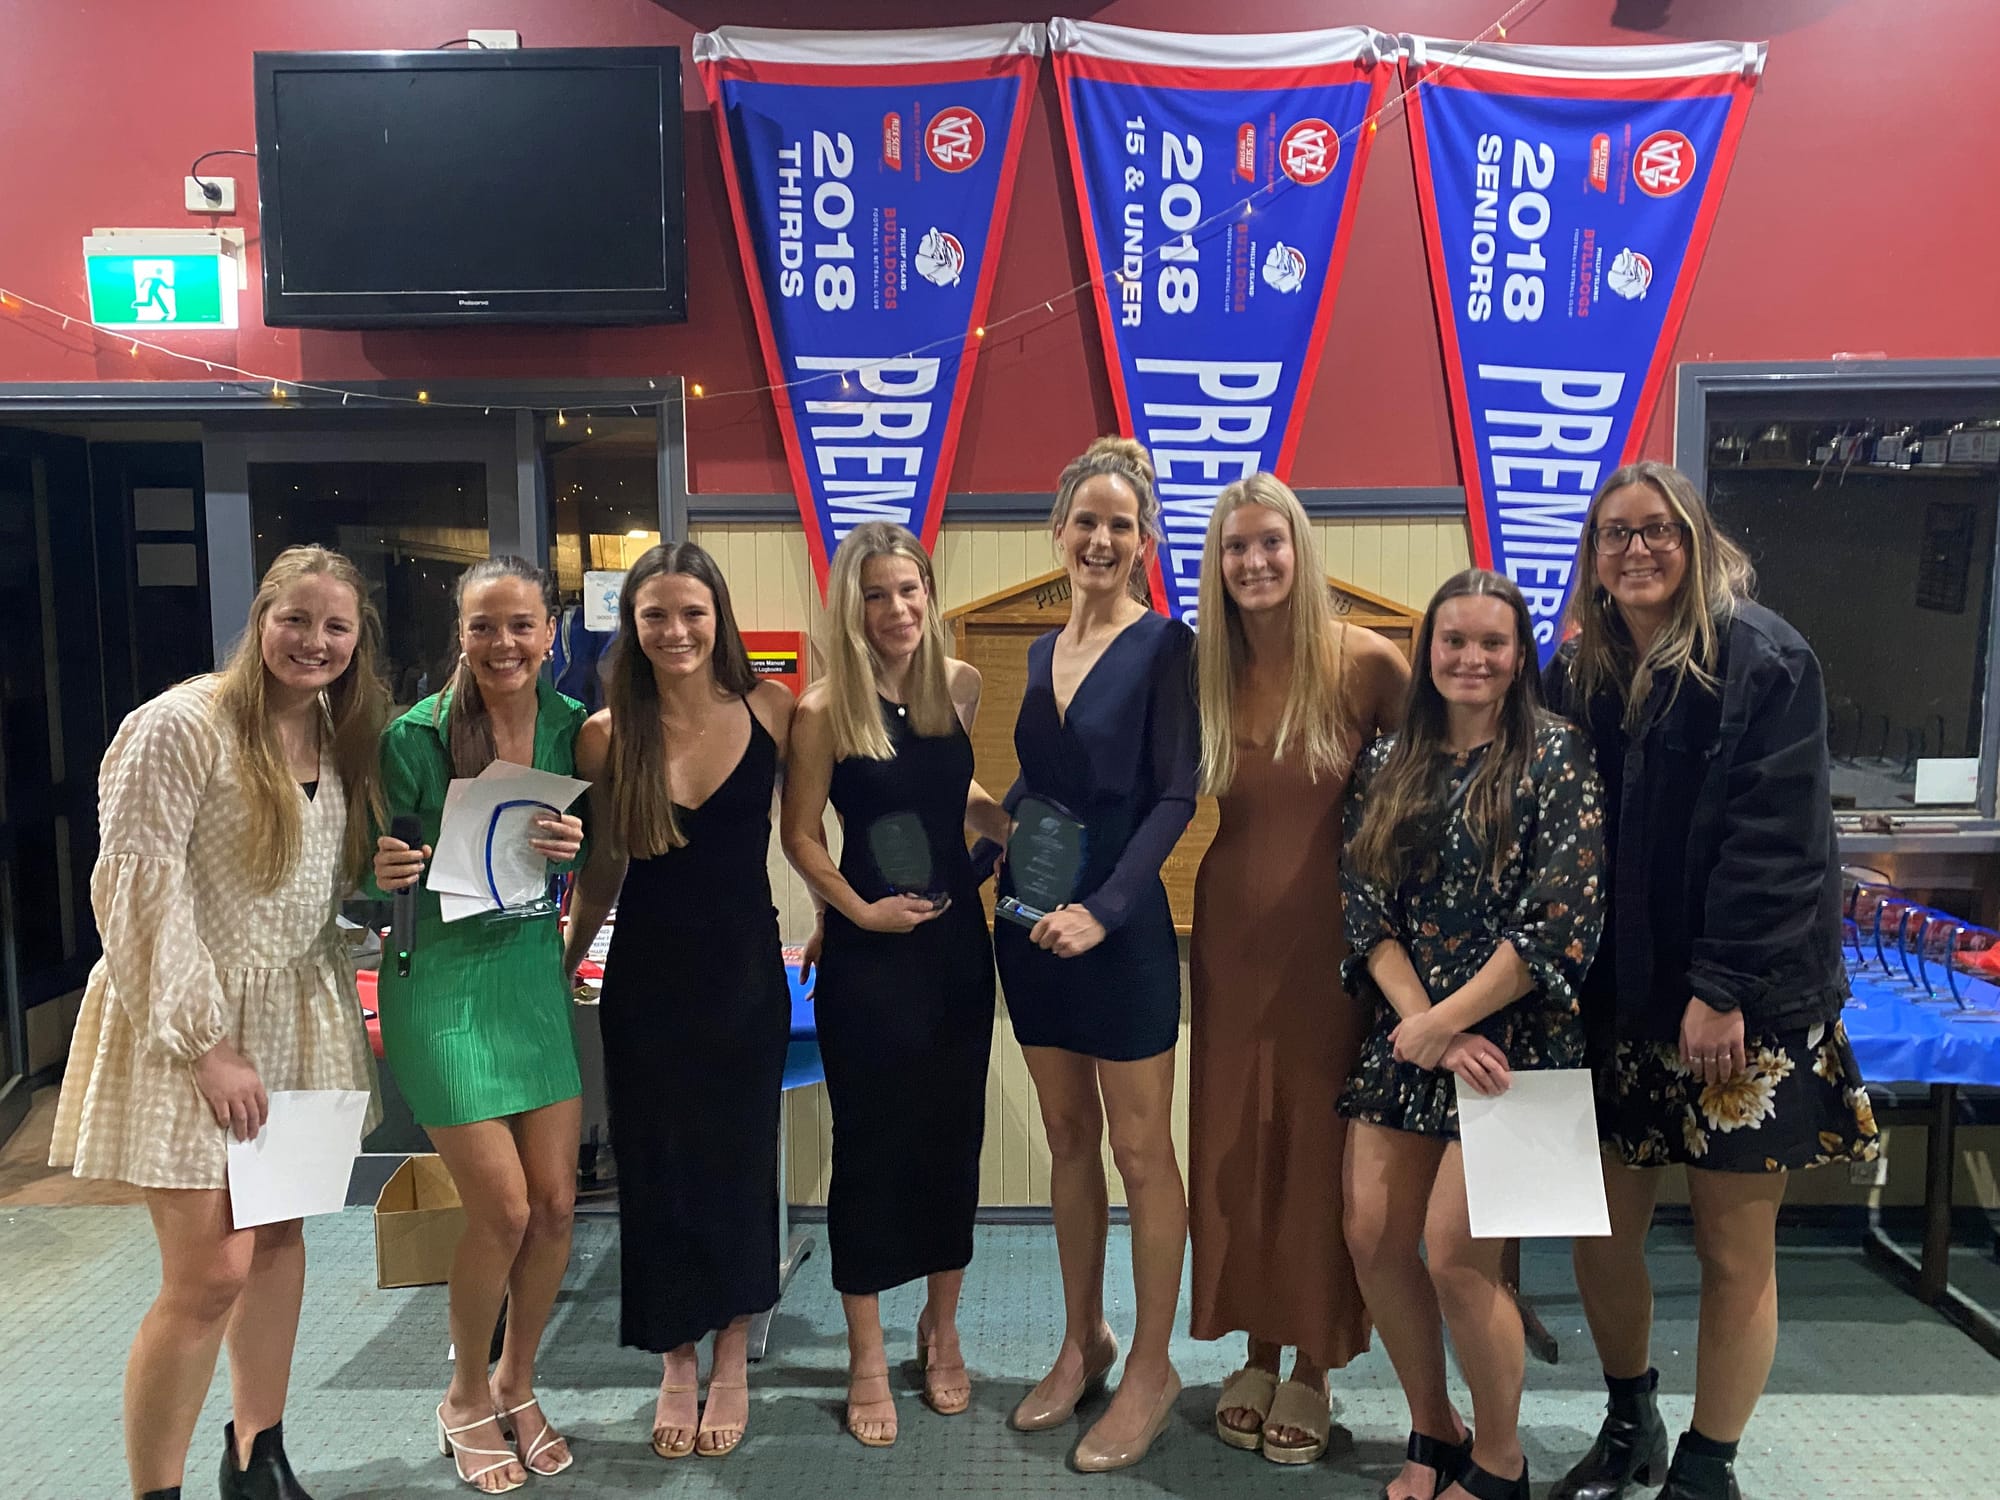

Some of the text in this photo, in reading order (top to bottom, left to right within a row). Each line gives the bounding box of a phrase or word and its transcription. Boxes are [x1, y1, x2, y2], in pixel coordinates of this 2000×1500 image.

[778, 142, 804, 297] THIRDS
[813, 130, 855, 311] 2018
[884, 208, 897, 309] BULLDOGS
[1122, 116, 1145, 327] 15 & UNDER
[1158, 131, 1203, 314] 2018
[1234, 224, 1248, 312] BULLDOGS
[1467, 133, 1502, 322] SENIORS
[1502, 139, 1555, 323] 2018
[1578, 229, 1595, 317] BULLDOGS
[795, 355, 941, 539] PREM
